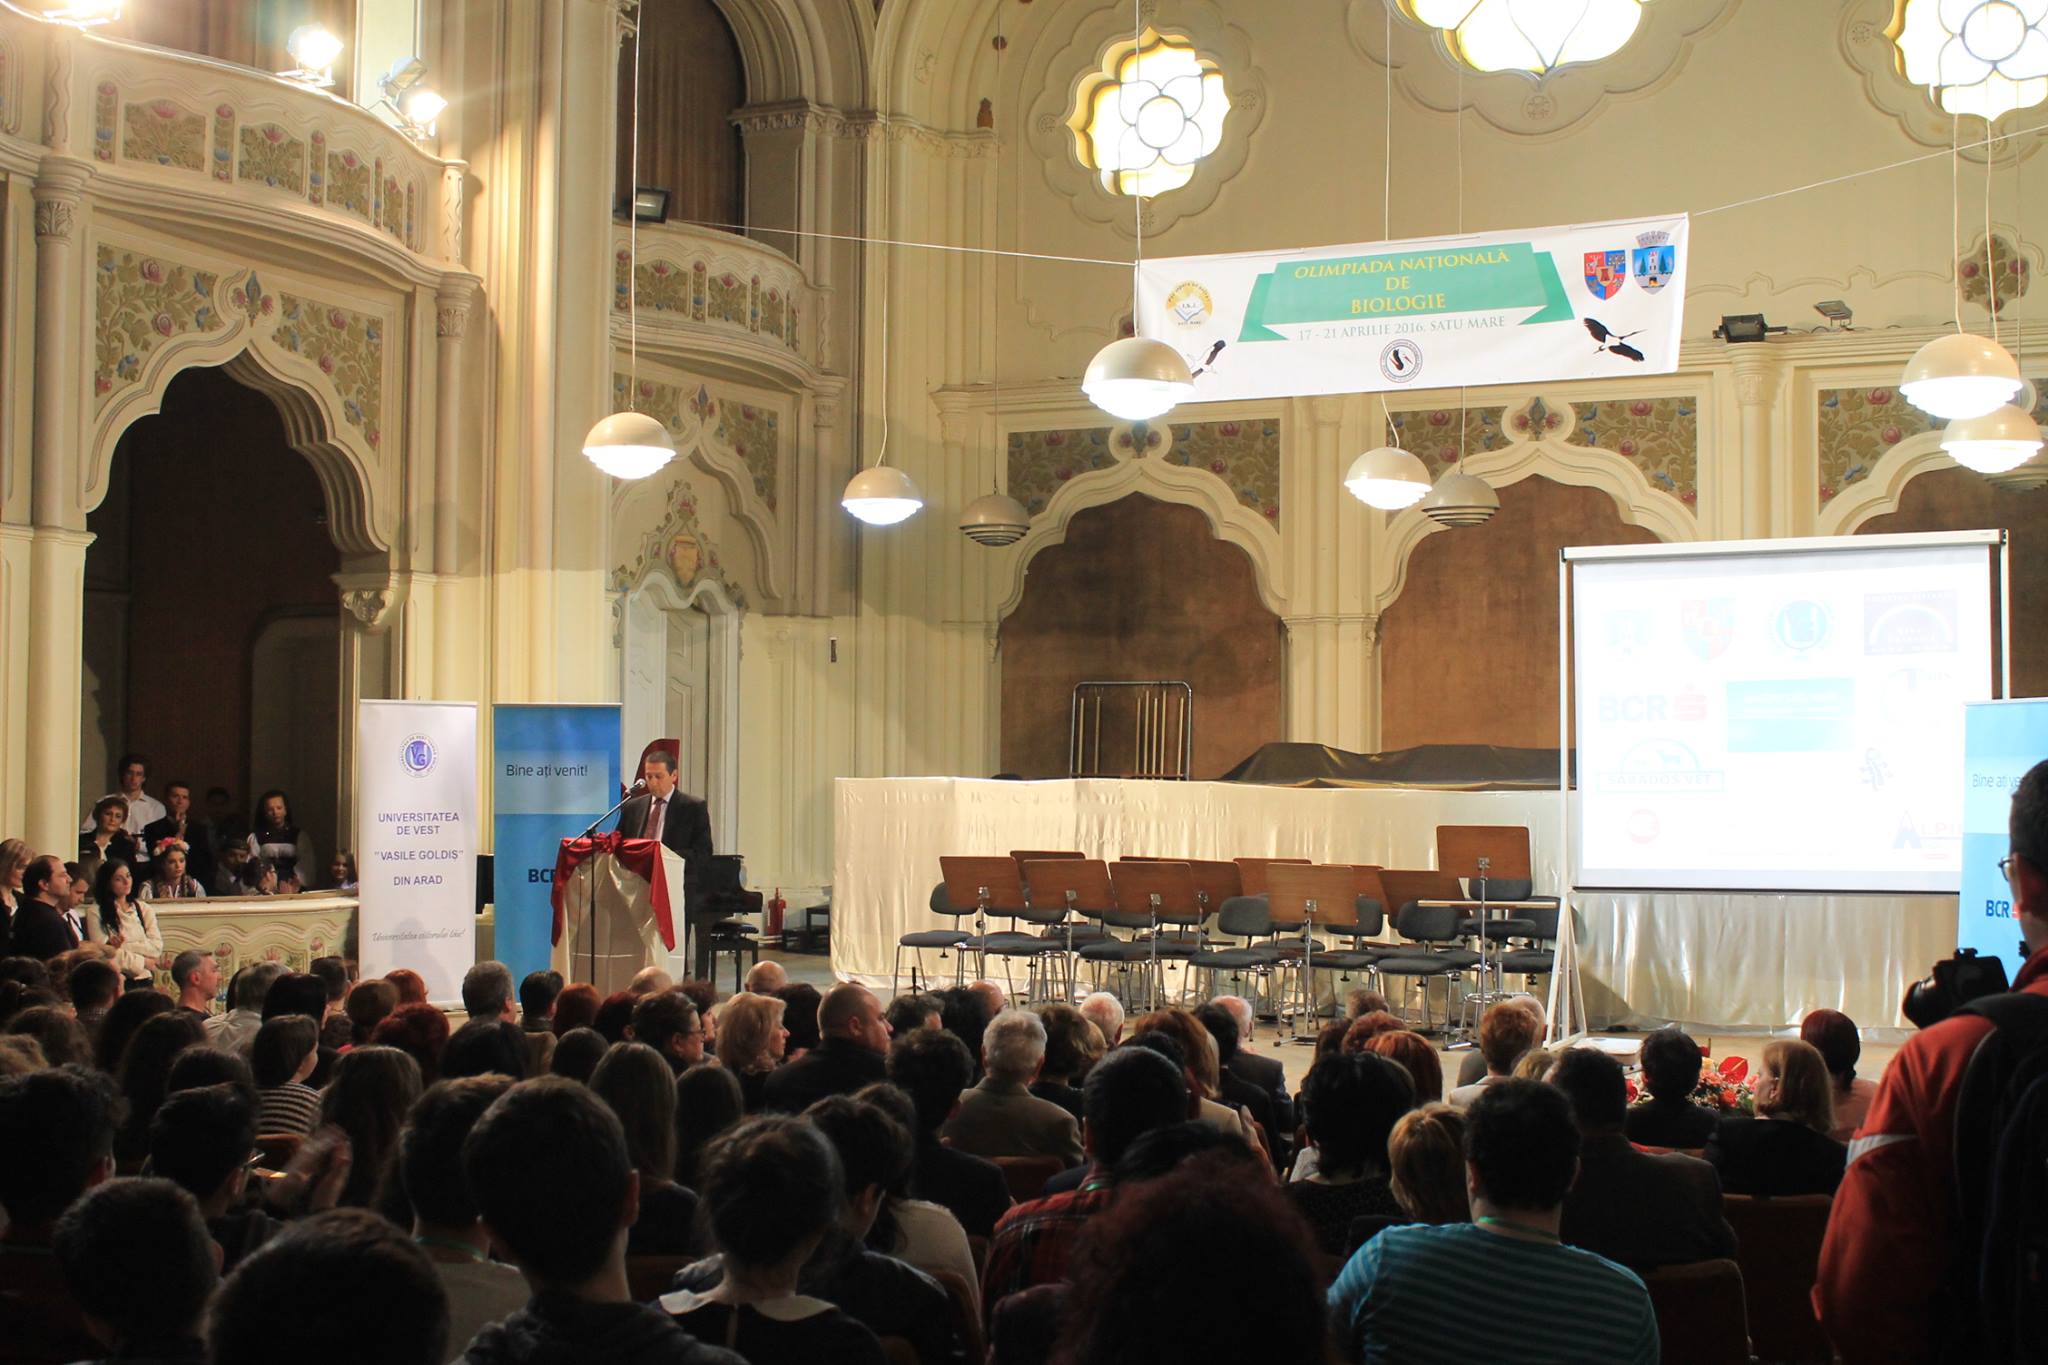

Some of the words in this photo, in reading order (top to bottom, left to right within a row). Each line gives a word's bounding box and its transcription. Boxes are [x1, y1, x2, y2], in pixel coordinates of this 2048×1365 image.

[1294, 259, 1395, 279] OLIMPIADA
[1385, 276, 1410, 291] DE
[1351, 293, 1446, 314] BIOLOGIE
[1299, 329, 1311, 341] 17
[1325, 328, 1336, 340] 21
[1341, 323, 1390, 338] APRILIE
[1430, 318, 1463, 331] SATU
[1467, 316, 1505, 329] MARE
[506, 764, 533, 776] Bine
[554, 764, 588, 776] venit!
[1972, 773, 1994, 788] Bine
[378, 812, 460, 822] UNIVERSITATEA
[396, 825, 410, 835] DE
[413, 825, 440, 835] VEST
[393, 876, 411, 886] DIN
[413, 875, 443, 885] ARAD
[1985, 900, 2010, 918] BCR
